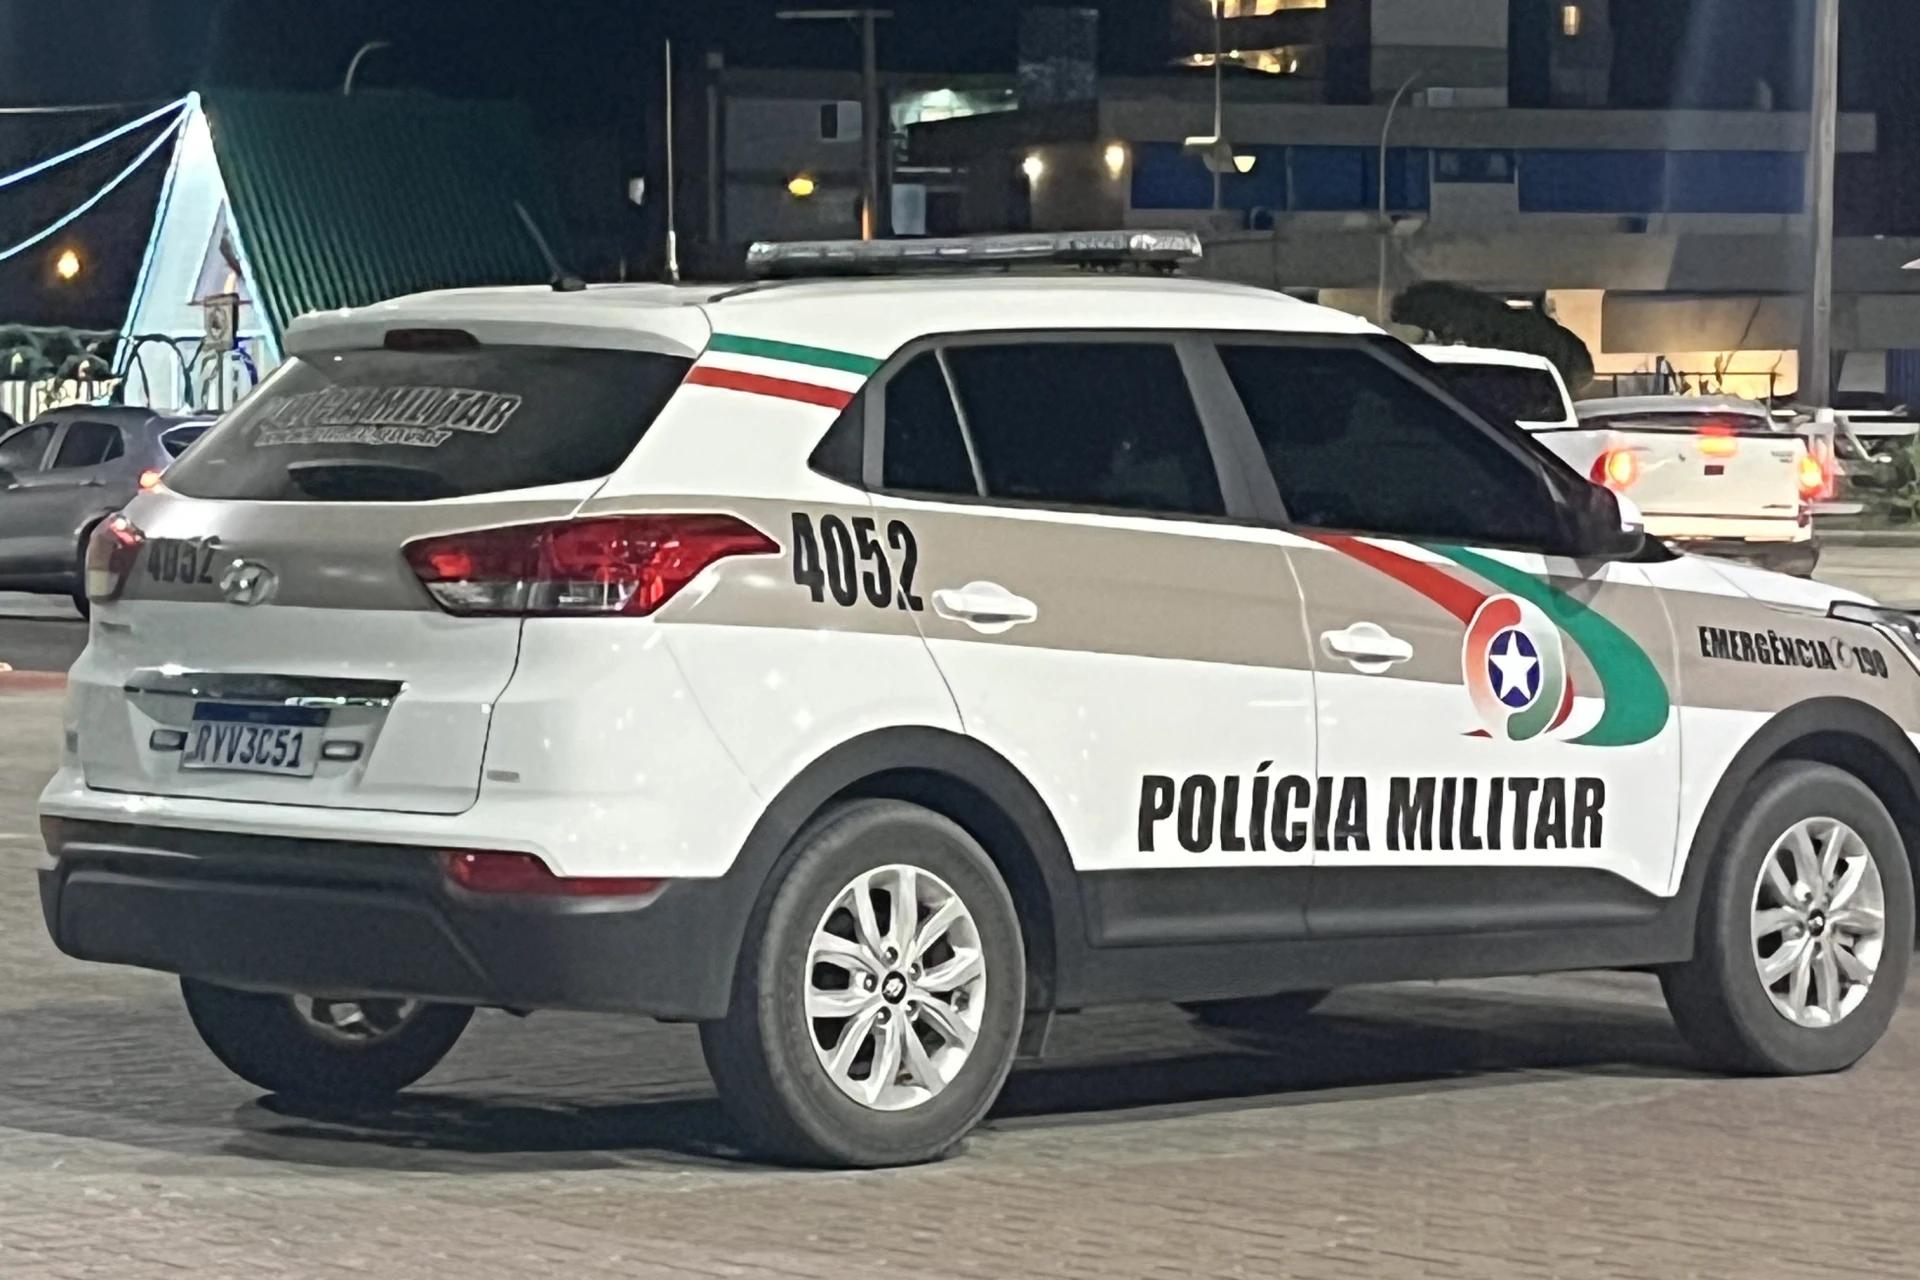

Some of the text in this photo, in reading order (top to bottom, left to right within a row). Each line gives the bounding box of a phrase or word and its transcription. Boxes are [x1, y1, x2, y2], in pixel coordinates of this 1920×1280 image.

[360, 386, 521, 434] MILITAR
[792, 512, 923, 611] 4052
[1698, 626, 1888, 679] EMERGÊNCIA 190
[191, 724, 303, 768] RYV3C51
[1138, 759, 1606, 853] POLÍCIA MILITAR
